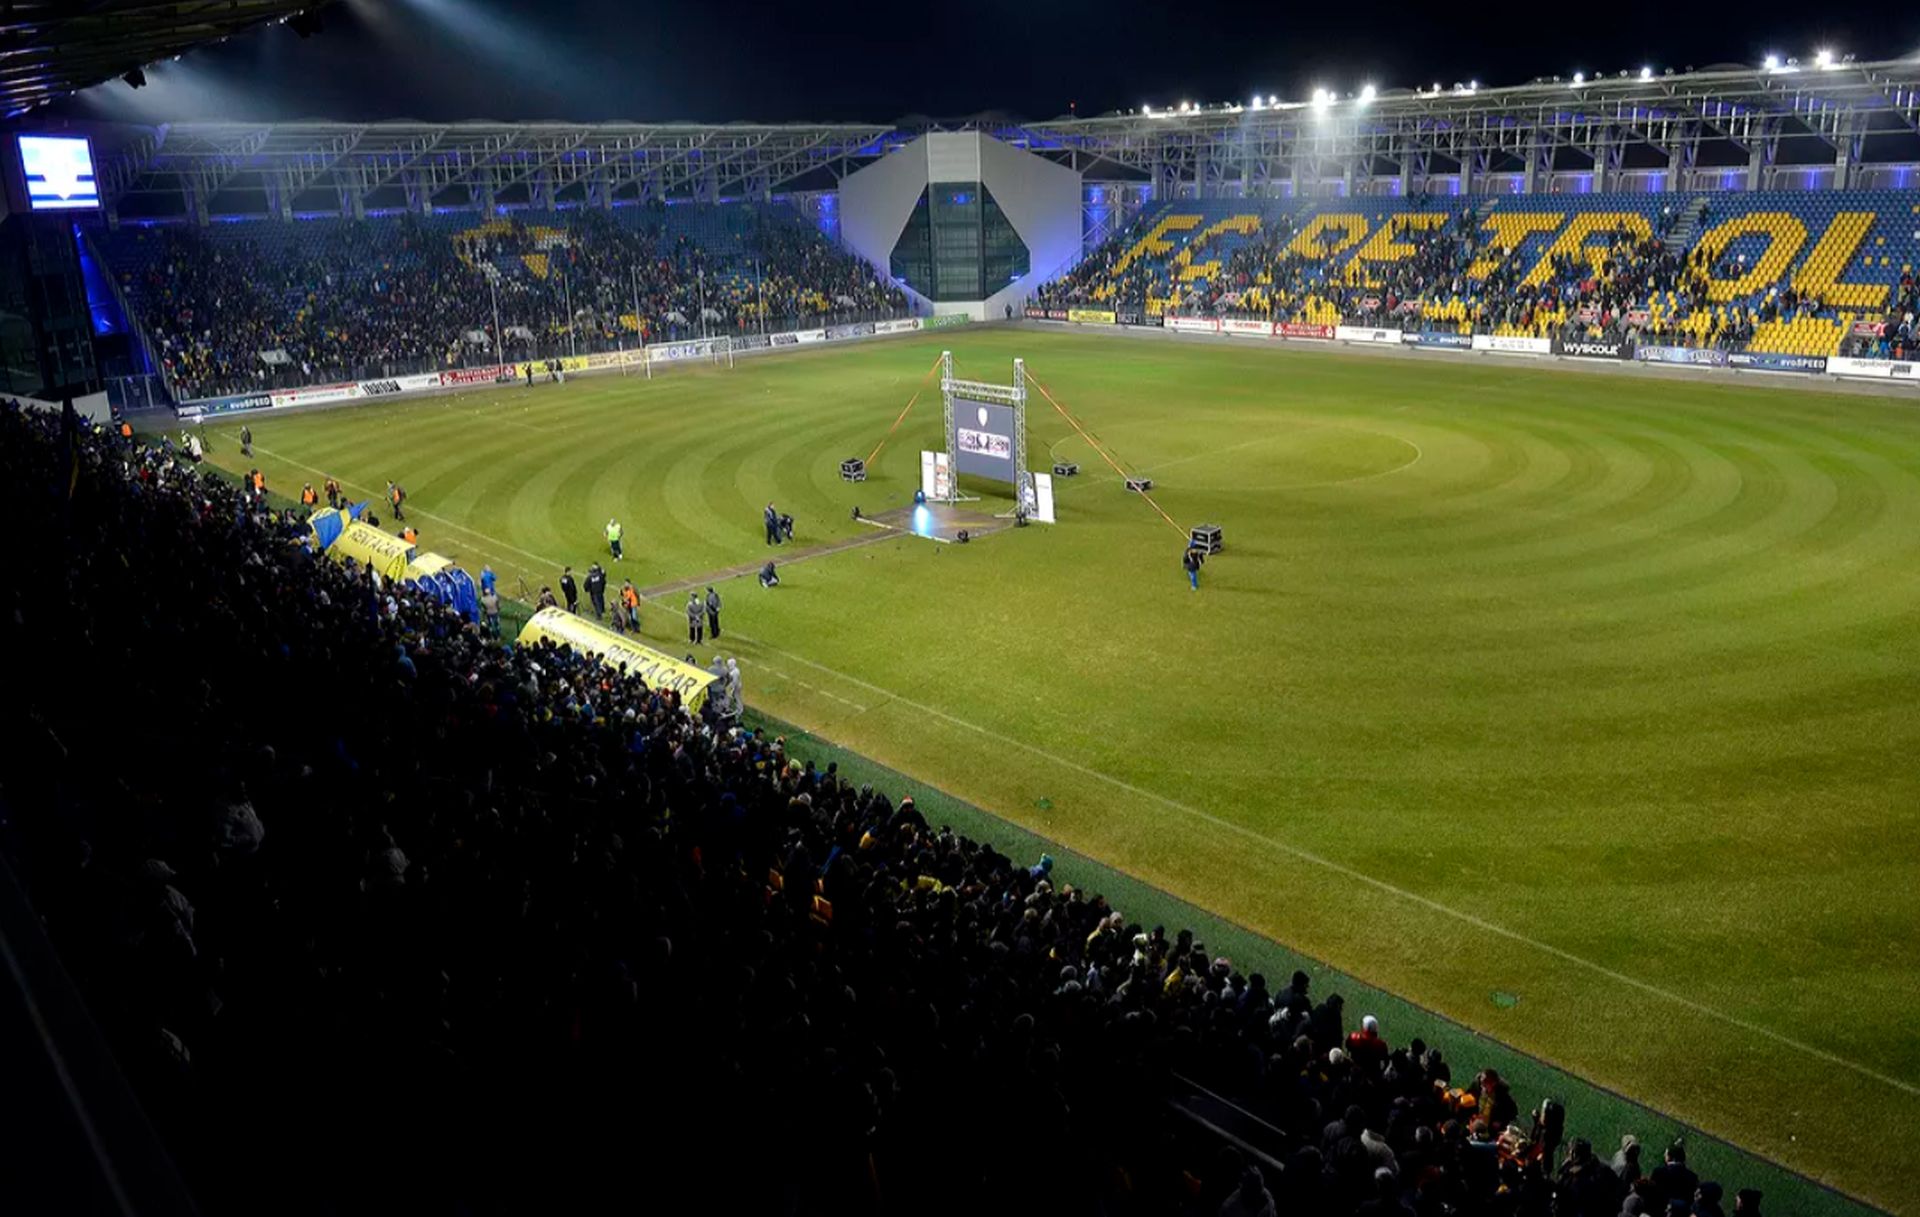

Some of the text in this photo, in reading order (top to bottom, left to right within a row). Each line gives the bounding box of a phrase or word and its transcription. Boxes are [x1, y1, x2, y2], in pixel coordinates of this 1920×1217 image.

[606, 644, 698, 696] RENT A CAR
